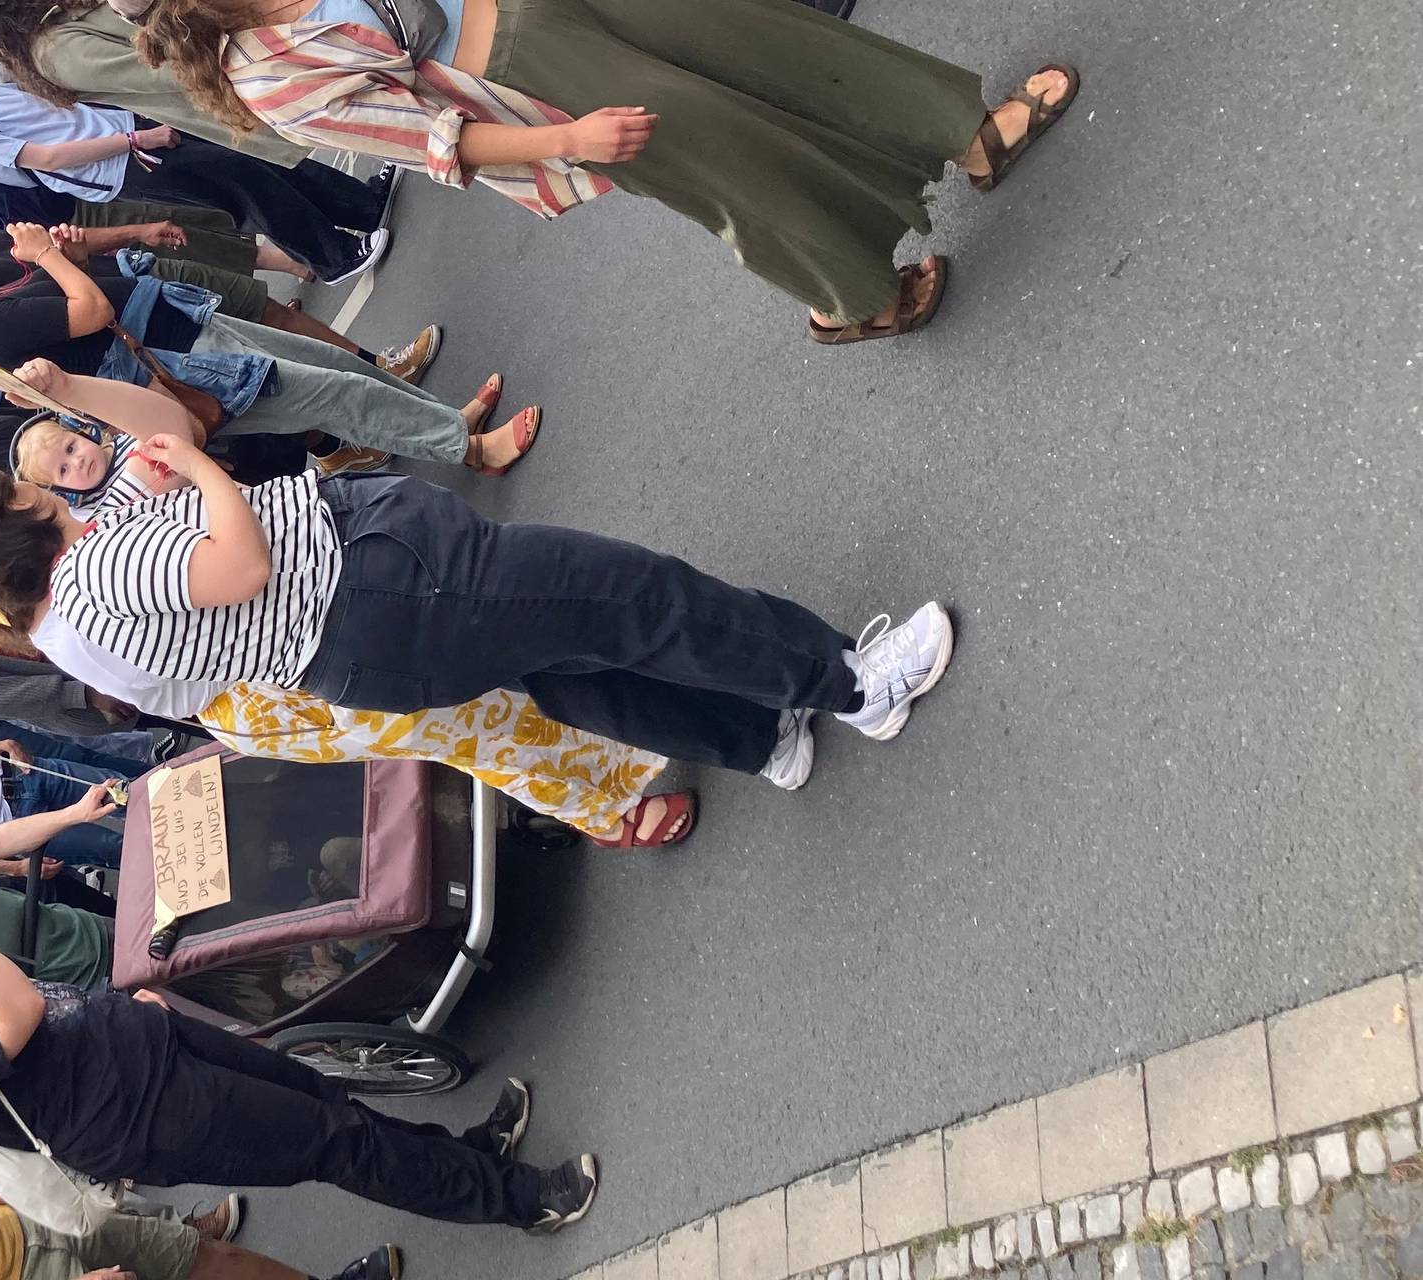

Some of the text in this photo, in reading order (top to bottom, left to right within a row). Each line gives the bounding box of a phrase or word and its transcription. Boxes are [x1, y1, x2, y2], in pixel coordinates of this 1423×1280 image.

[151, 804, 176, 889] BRAUN
[171, 776, 189, 910] SIND BEI UNS NUR
[203, 770, 223, 856] WINDELN!
[192, 820, 209, 899] DIE VOLLEN
